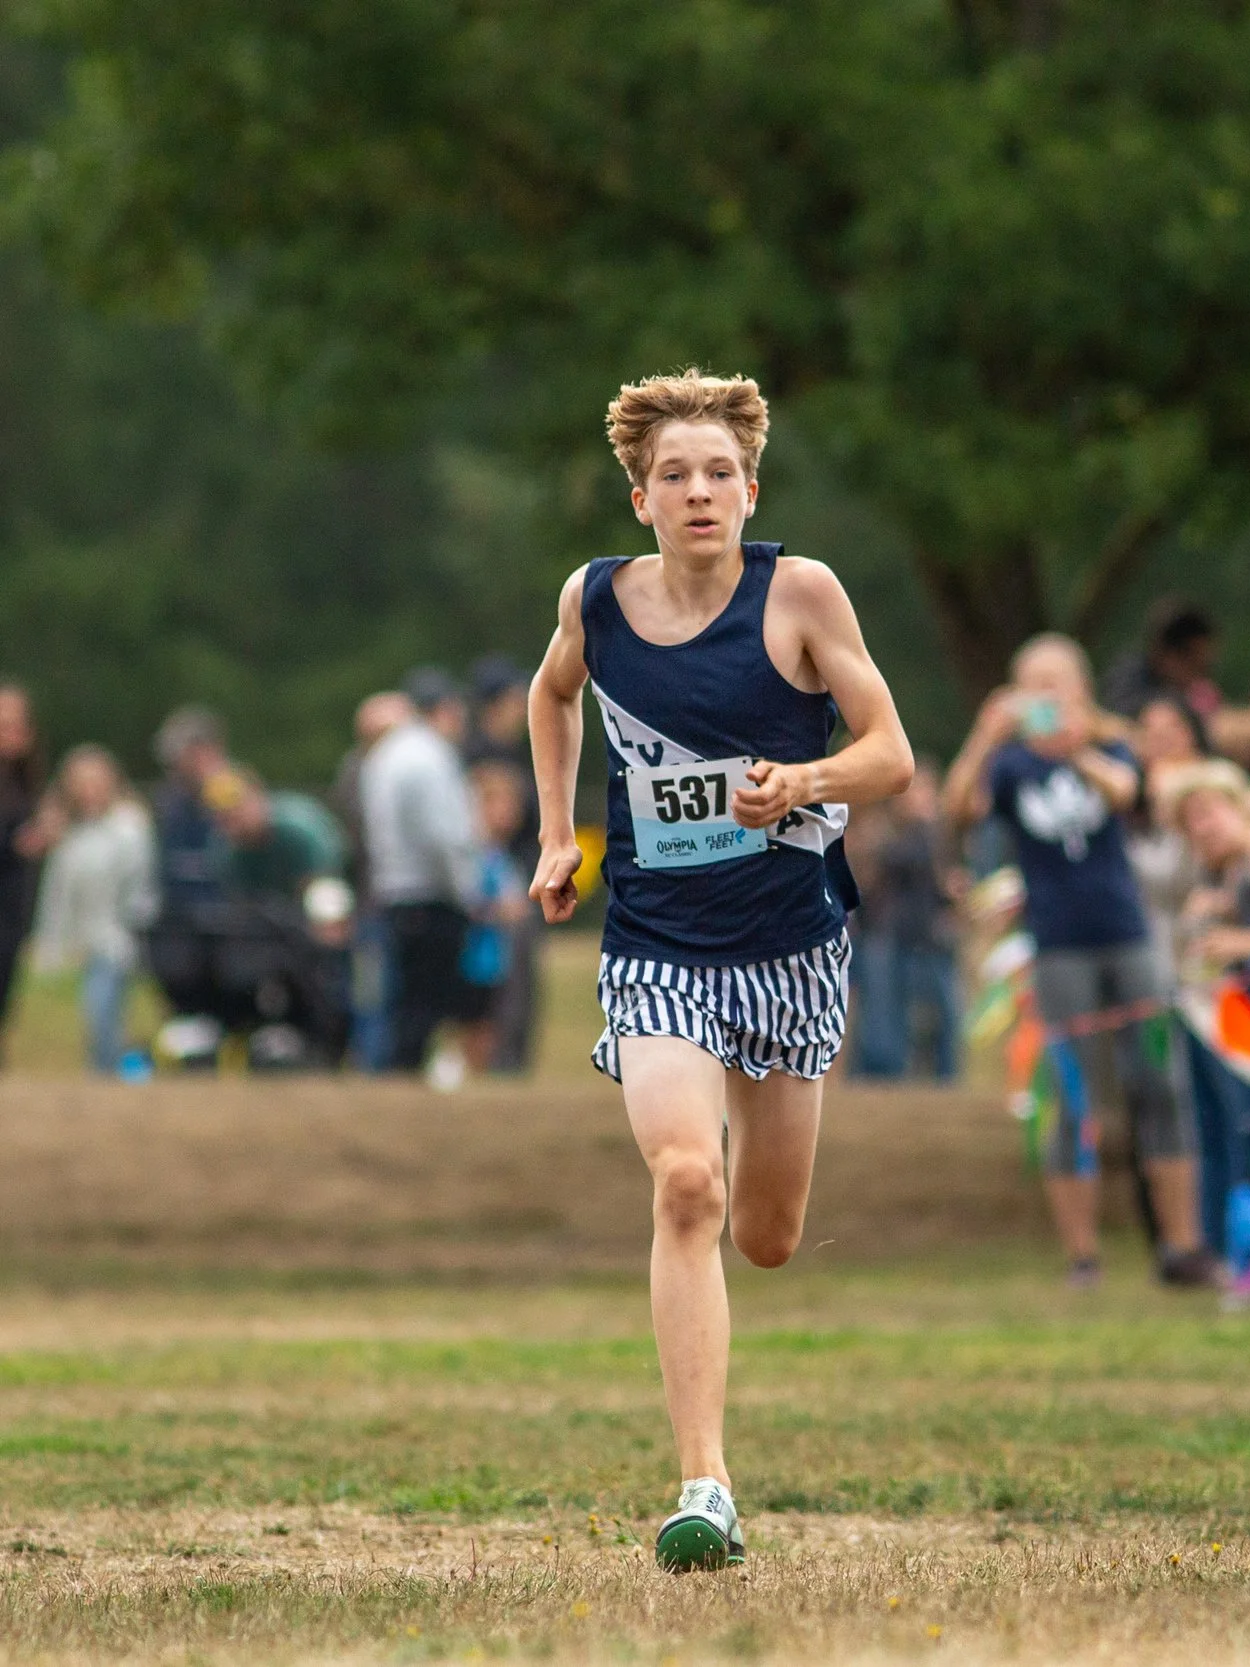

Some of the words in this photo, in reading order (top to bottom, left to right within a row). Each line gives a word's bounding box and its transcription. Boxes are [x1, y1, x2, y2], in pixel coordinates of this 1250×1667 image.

[651, 772, 726, 824] 537
[705, 831, 736, 844] FLEET
[657, 839, 698, 853] OLYMPIA
[710, 840, 733, 851] FEET
